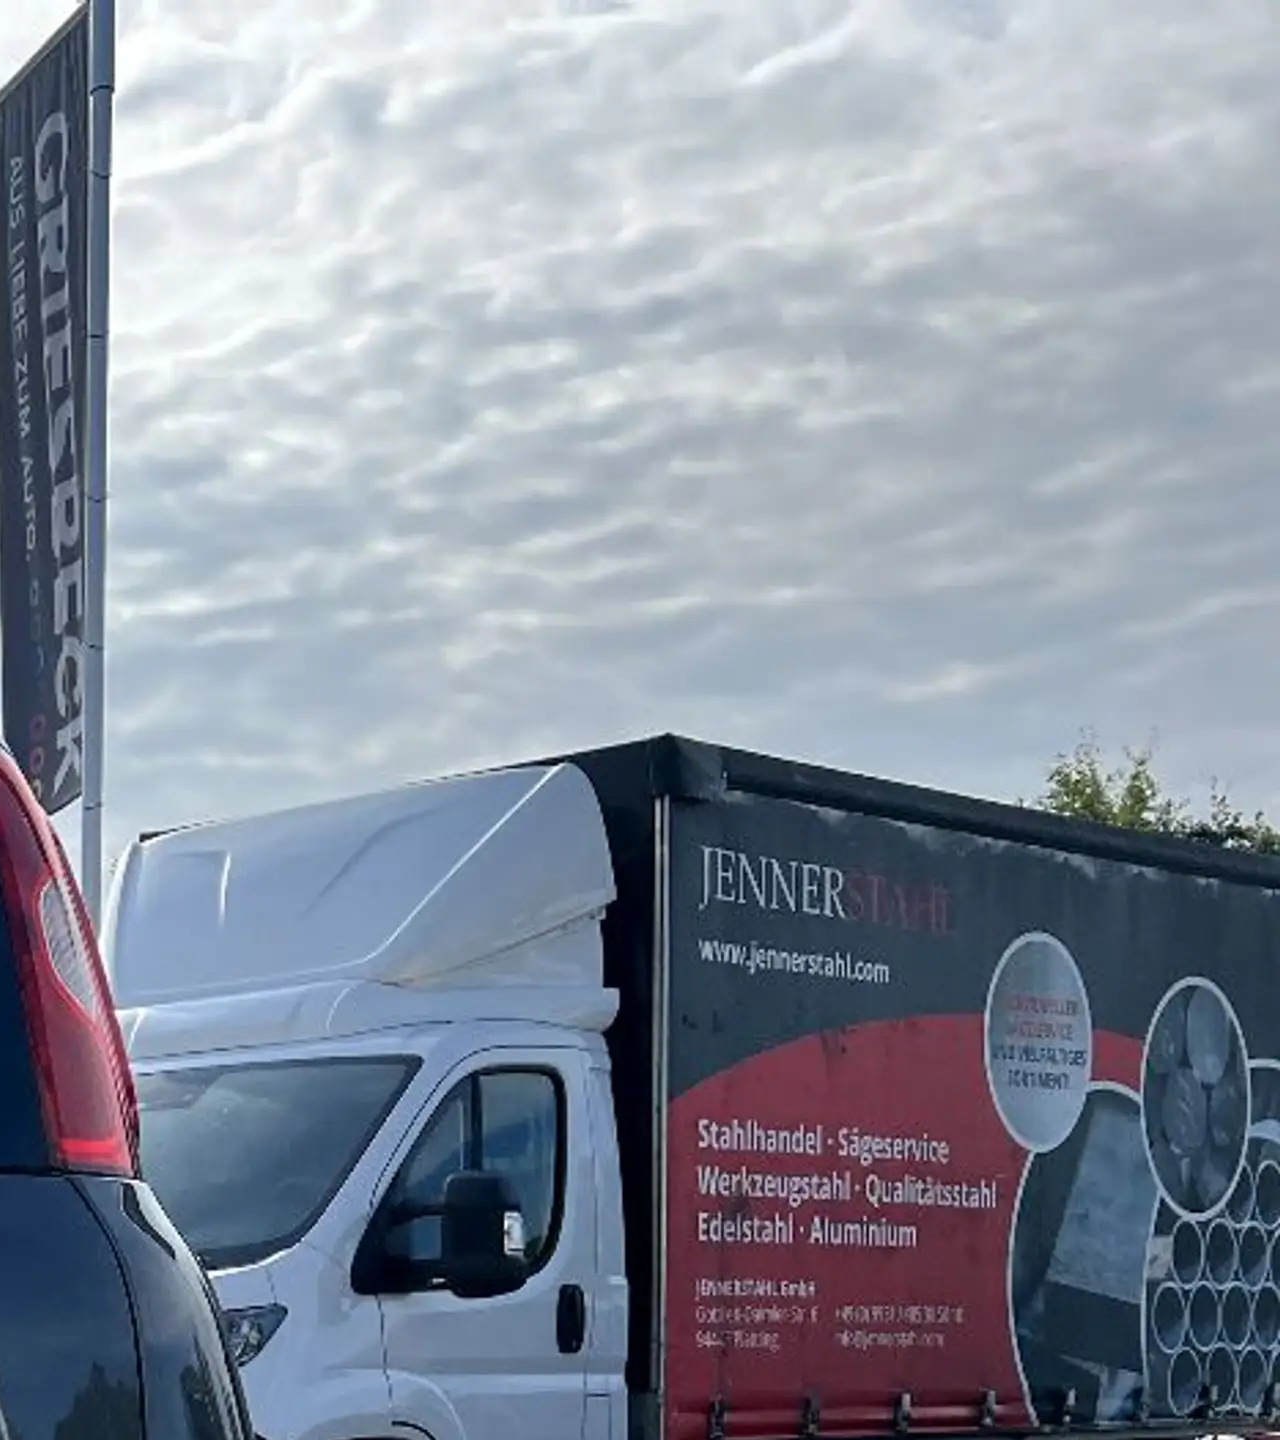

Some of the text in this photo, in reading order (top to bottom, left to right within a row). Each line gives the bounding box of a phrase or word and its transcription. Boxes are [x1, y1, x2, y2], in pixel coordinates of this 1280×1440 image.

[9, 156, 26, 229] AUS
[11, 240, 28, 340] LIEBE
[14, 352, 31, 438] ZUM
[35, 112, 82, 798] GRIESBECK
[698, 939, 890, 983] www.jennerstahl.com
[697, 1119, 951, 1165] Stahlhandel Sägeservice
[697, 1165, 997, 1208] Werkzeugstahl Qualitätsstahl
[697, 1212, 917, 1248] Edelstahl Aluminium
